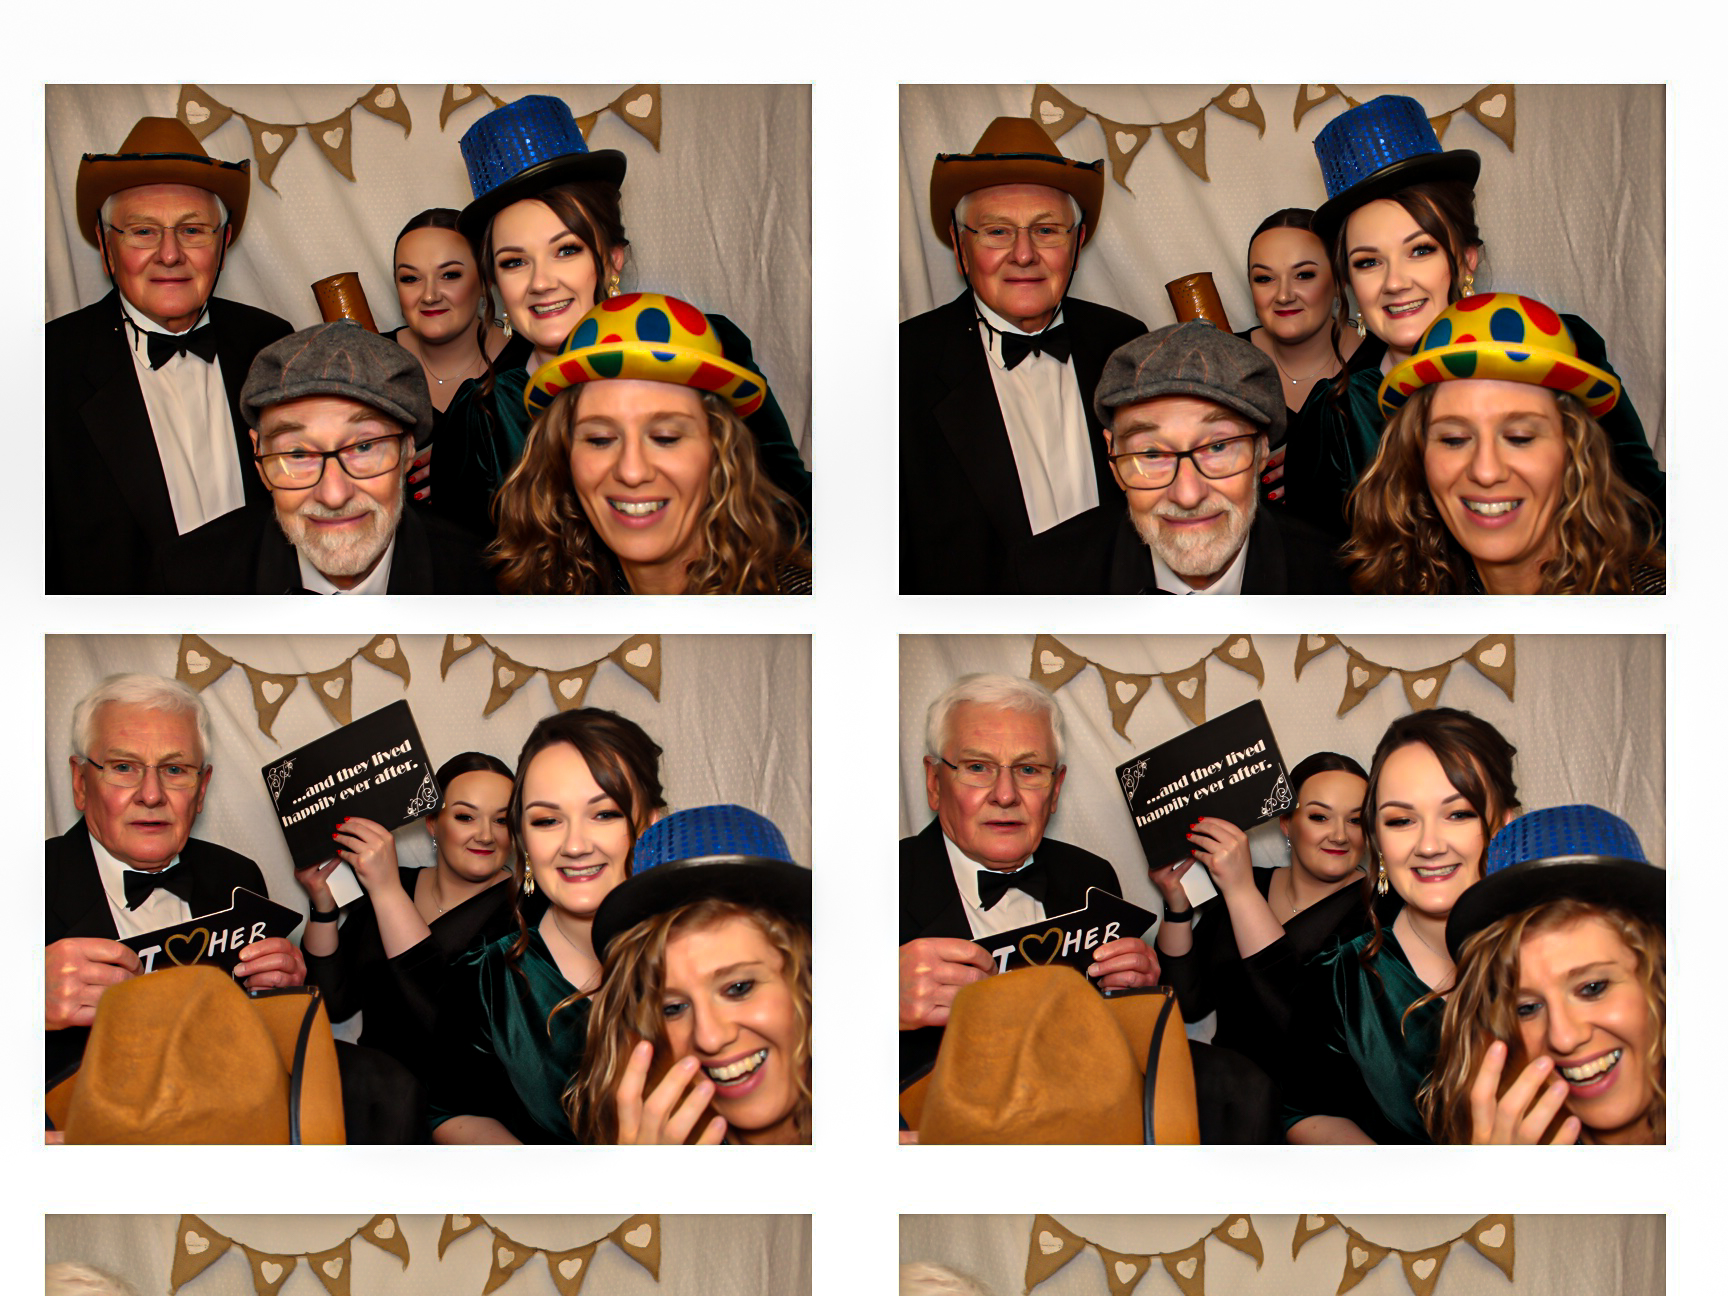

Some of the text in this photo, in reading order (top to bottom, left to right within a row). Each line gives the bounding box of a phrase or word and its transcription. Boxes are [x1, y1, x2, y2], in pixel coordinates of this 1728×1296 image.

[336, 759, 370, 783] they
[371, 739, 413, 768] lived
[1190, 759, 1224, 783] they
[1225, 739, 1267, 768] lived
[281, 760, 419, 828] happily ever after.
[1135, 760, 1273, 828] happily ever after.
[138, 921, 267, 975] I HER
[992, 921, 1121, 975] I HER
